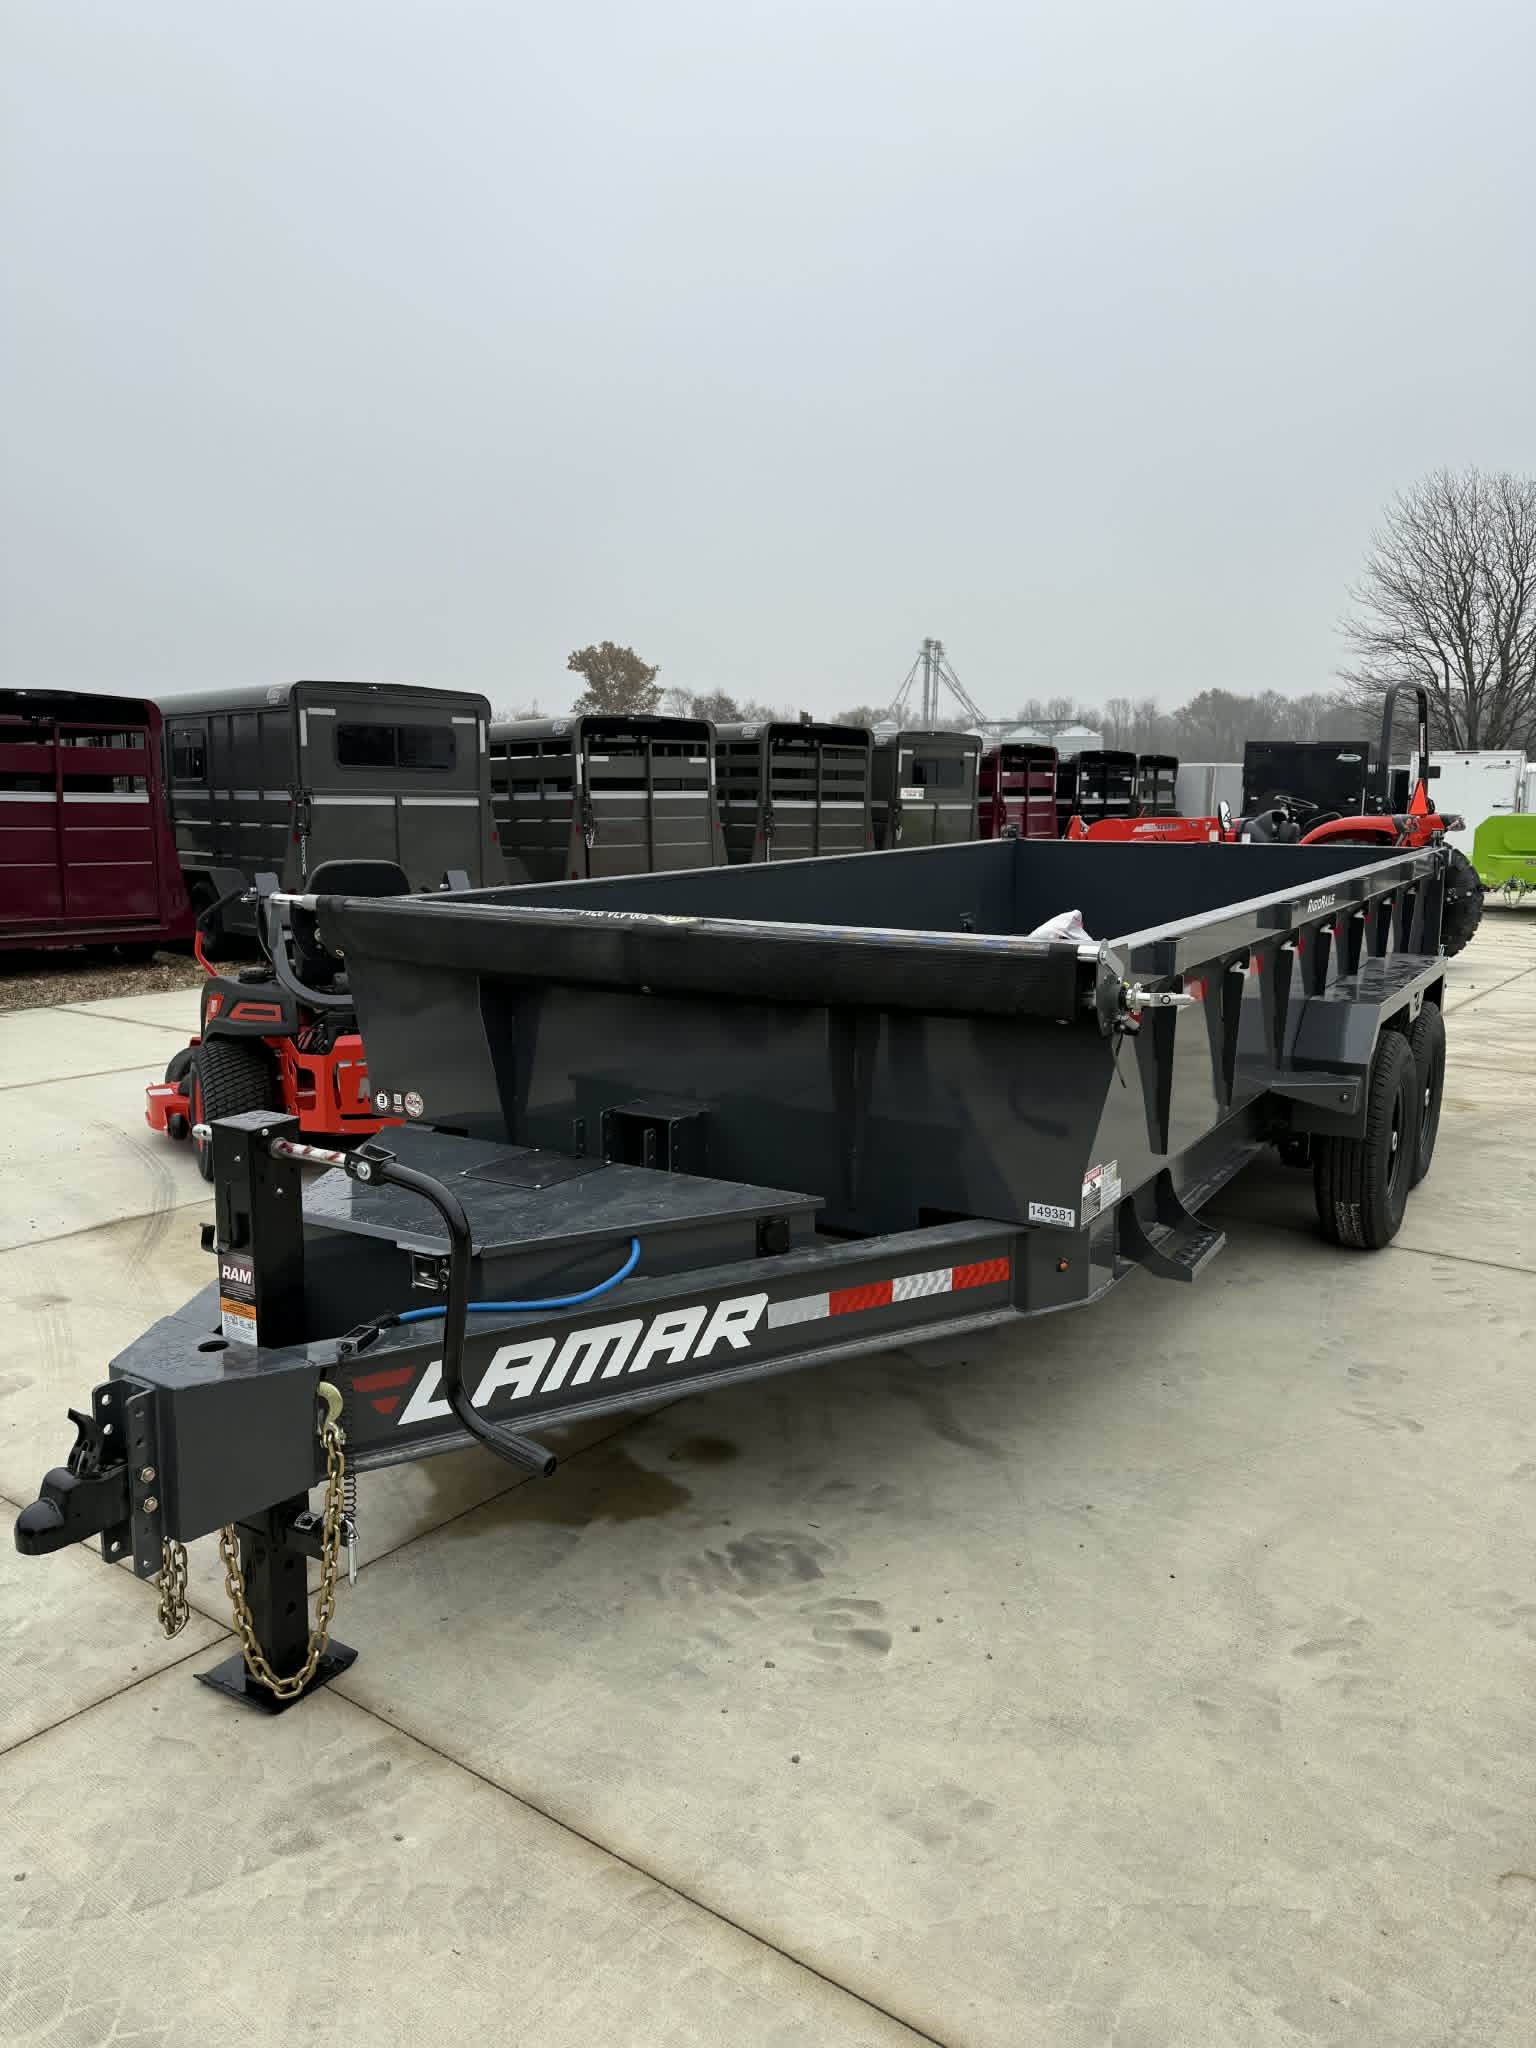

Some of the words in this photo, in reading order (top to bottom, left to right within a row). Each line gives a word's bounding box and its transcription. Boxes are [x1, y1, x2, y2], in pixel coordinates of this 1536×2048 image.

[1031, 1205, 1073, 1221] 149381
[222, 1264, 252, 1285] RAM
[398, 1293, 769, 1425] LAMAR
